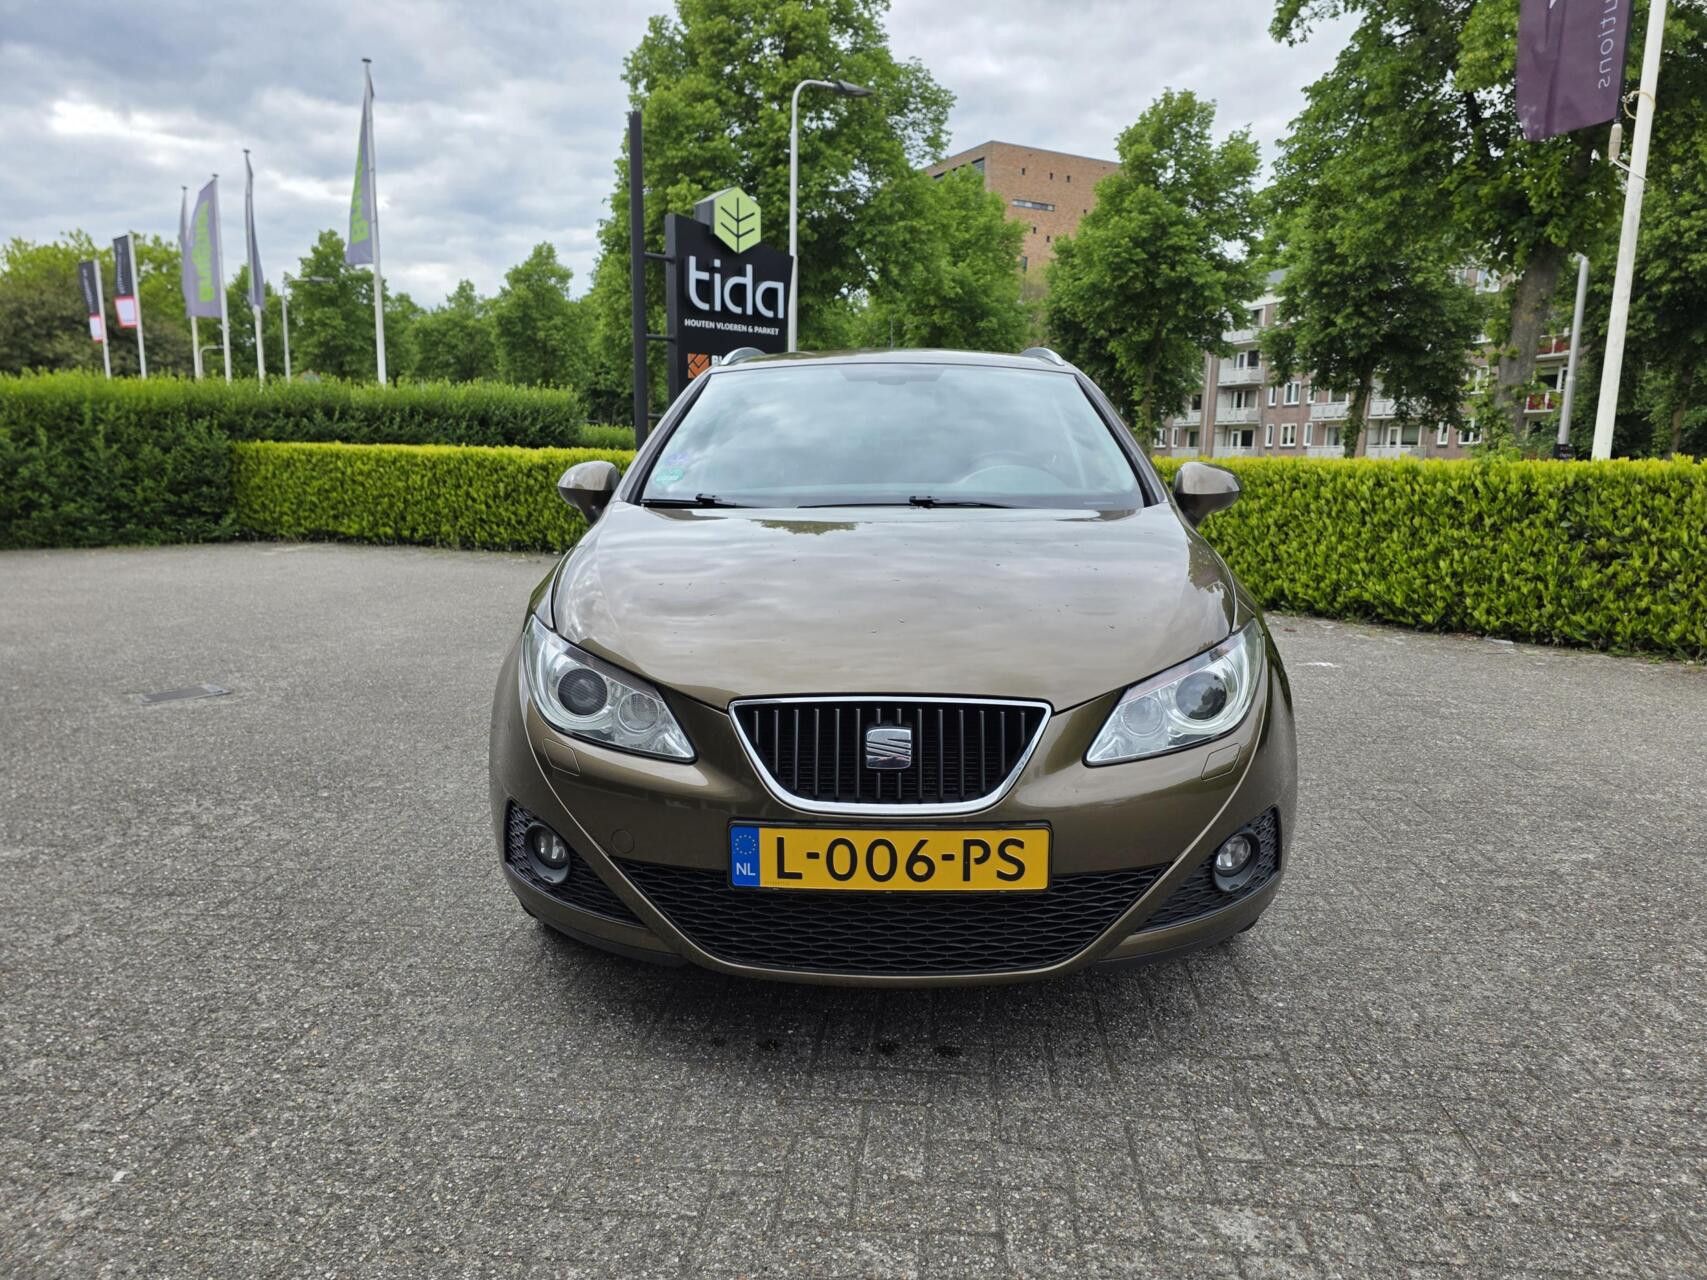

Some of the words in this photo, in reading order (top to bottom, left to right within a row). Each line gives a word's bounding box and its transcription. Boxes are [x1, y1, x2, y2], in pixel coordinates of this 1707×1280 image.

[688, 255, 784, 319] tida
[684, 318, 715, 329] HOUTEN
[716, 322, 747, 332] VLOEREN
[748, 325, 753, 333] &
[754, 326, 779, 336] PARKET
[735, 862, 756, 876] NL
[776, 837, 1026, 882] L-006-PS
